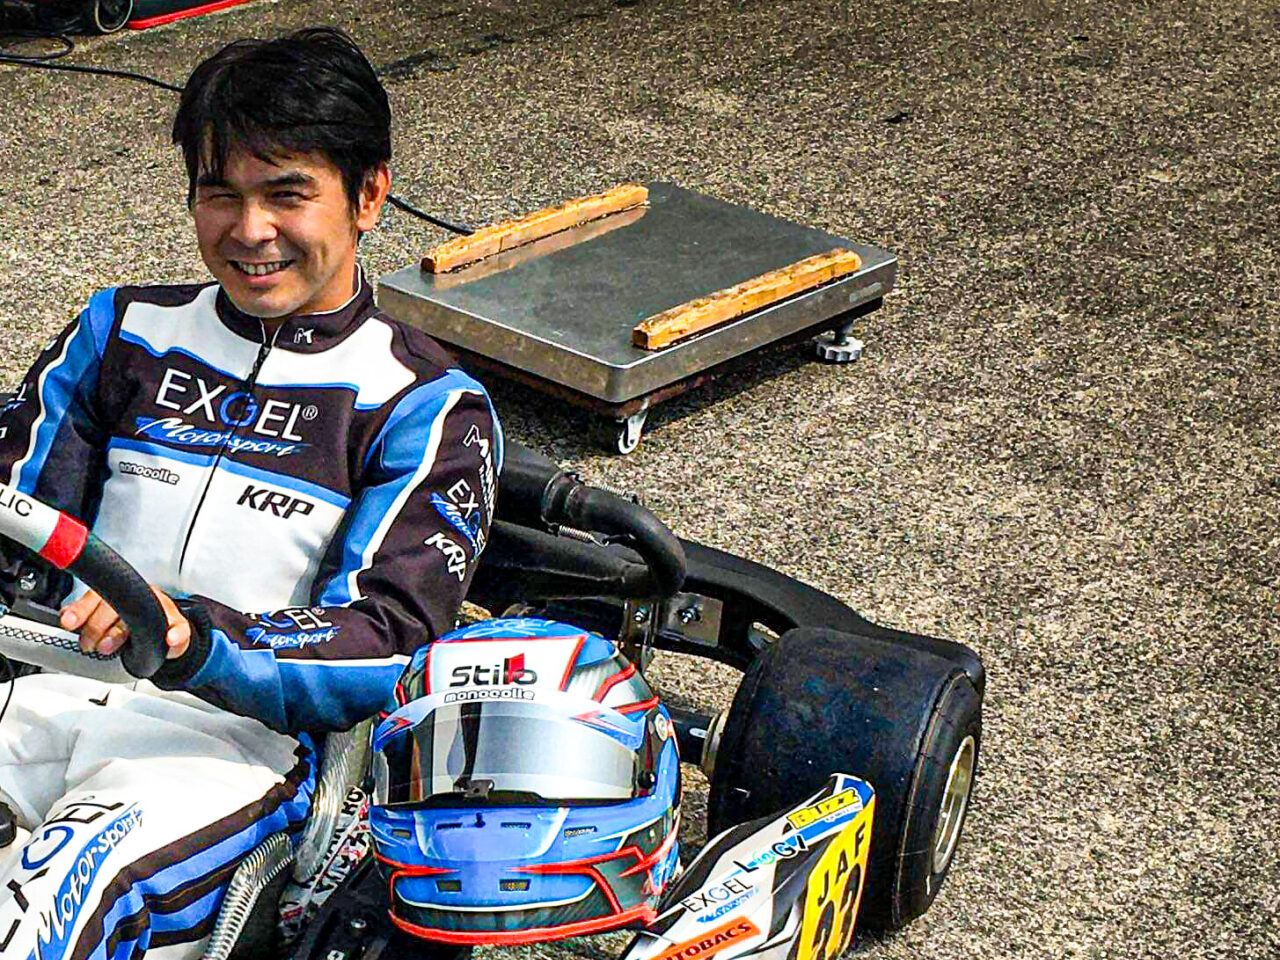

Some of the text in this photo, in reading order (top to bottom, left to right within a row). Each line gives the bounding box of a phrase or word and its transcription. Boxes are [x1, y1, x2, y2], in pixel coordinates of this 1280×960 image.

[135, 417, 297, 457] Motorsport
[236, 484, 315, 519] KRP
[424, 532, 466, 582] KRP
[449, 653, 538, 687] Stilo
[817, 822, 867, 908] JAF
[681, 876, 754, 913] EXGEL
